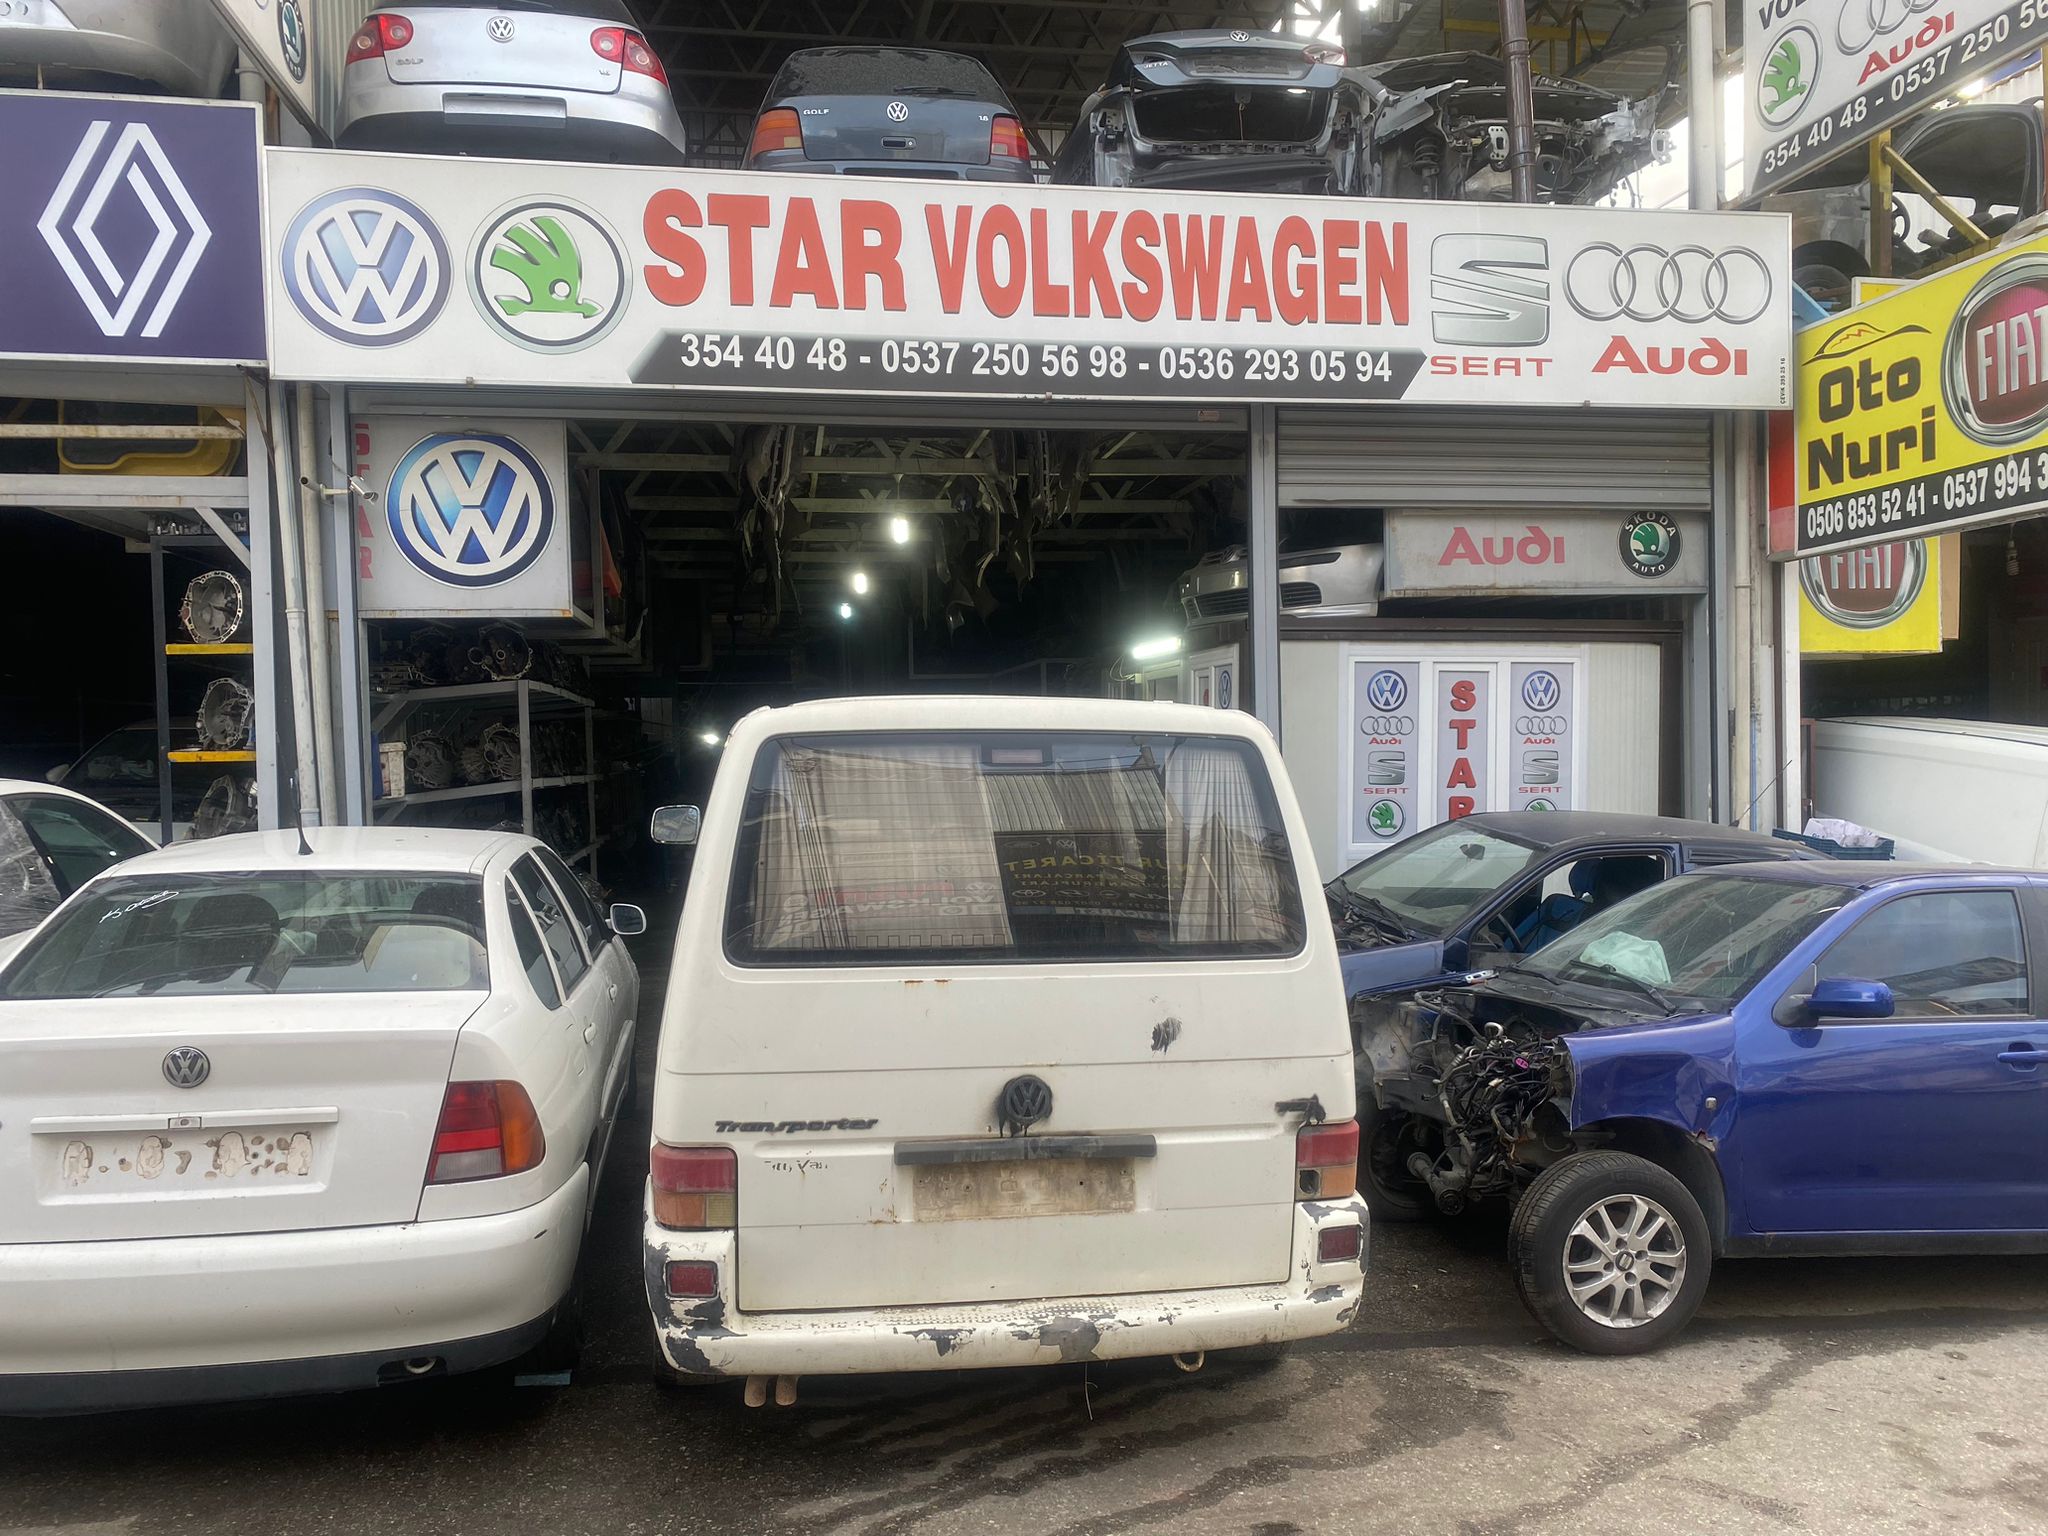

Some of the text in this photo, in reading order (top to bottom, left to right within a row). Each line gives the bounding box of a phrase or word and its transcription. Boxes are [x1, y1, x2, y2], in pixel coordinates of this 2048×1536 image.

[1144, 61, 1169, 69] JETTA
[1764, 134, 1801, 174] 354
[1807, 116, 1833, 147] 40
[1839, 96, 1867, 129] 48
[1891, 45, 1953, 101] 0537
[1961, 14, 2010, 63] 250
[643, 187, 1409, 327] STAR VOLKSWAGEN
[680, 332, 1392, 383] 354 40 48 - 0537 250 56 98 - 0536 293 05 94
[1430, 355, 1553, 378] SEAT
[1818, 356, 1922, 424] Oto
[1807, 404, 1937, 492] Nuri
[1807, 501, 1844, 539] 0506
[1847, 494, 1877, 530] 853
[1881, 487, 1902, 524] 52
[1906, 482, 1926, 518] 41
[1943, 465, 1989, 511] 0537
[1994, 456, 2032, 500] 994
[1632, 561, 1666, 574] AUTO
[1363, 787, 1410, 795] SEAT
[1518, 786, 1563, 794] SEAT
[714, 1117, 879, 1134] Transporter
